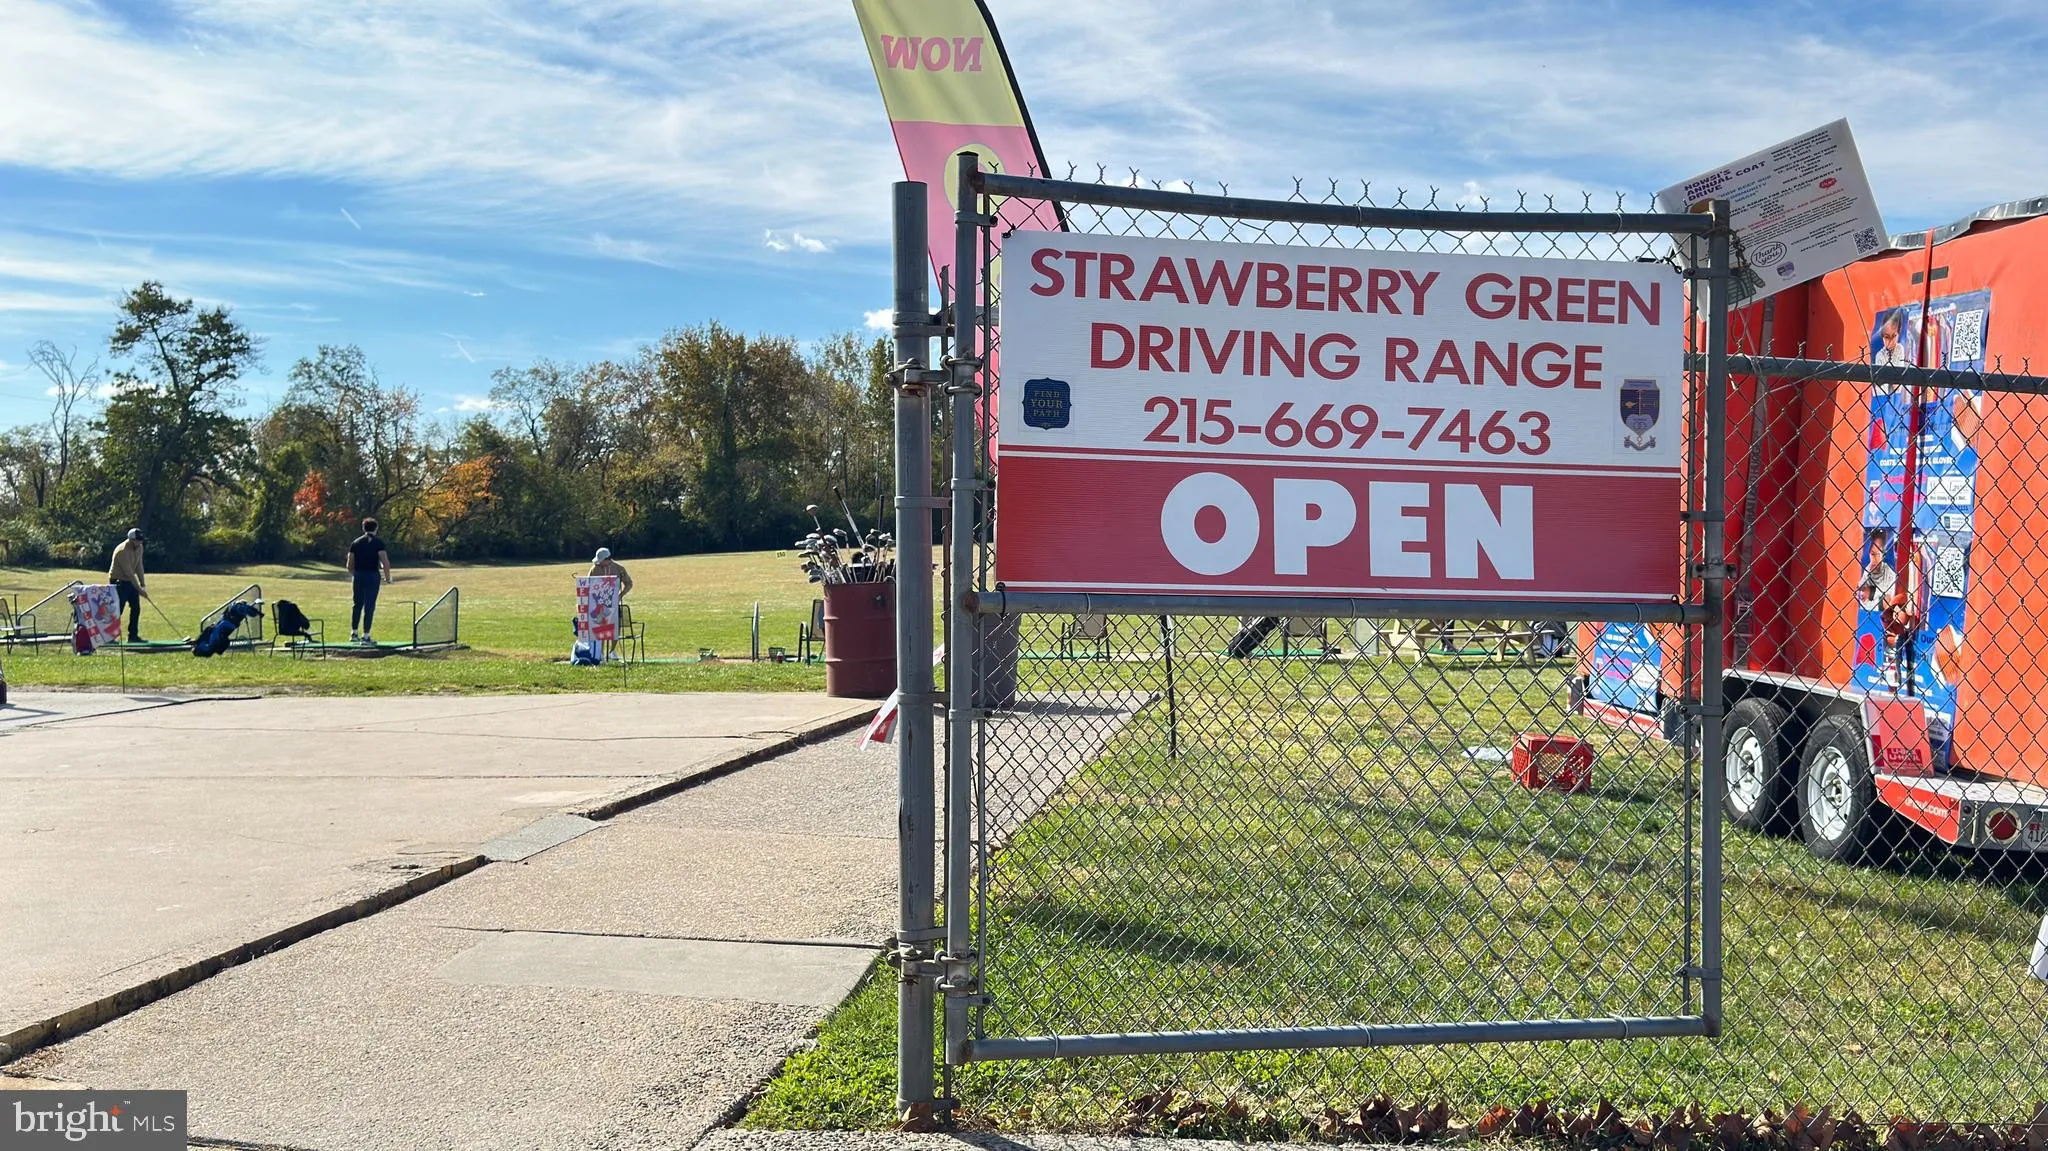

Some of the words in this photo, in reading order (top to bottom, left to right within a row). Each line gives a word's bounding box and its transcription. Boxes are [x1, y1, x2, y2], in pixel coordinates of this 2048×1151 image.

[1685, 174, 1732, 196] ANNUAL
[1734, 160, 1766, 176] COAT
[1687, 184, 1722, 201] DRIVE
[1753, 241, 1783, 260] Thank
[1761, 251, 1780, 265] you
[1031, 248, 1440, 316] STRAWBERRY
[1465, 273, 1661, 325] GREEN
[1091, 322, 1361, 380] DRIVING
[1385, 337, 1603, 390] RANGE
[1032, 399, 1062, 408] YOUR
[1145, 396, 1551, 455] 215-669-7463
[1161, 472, 1534, 579] OPEN
